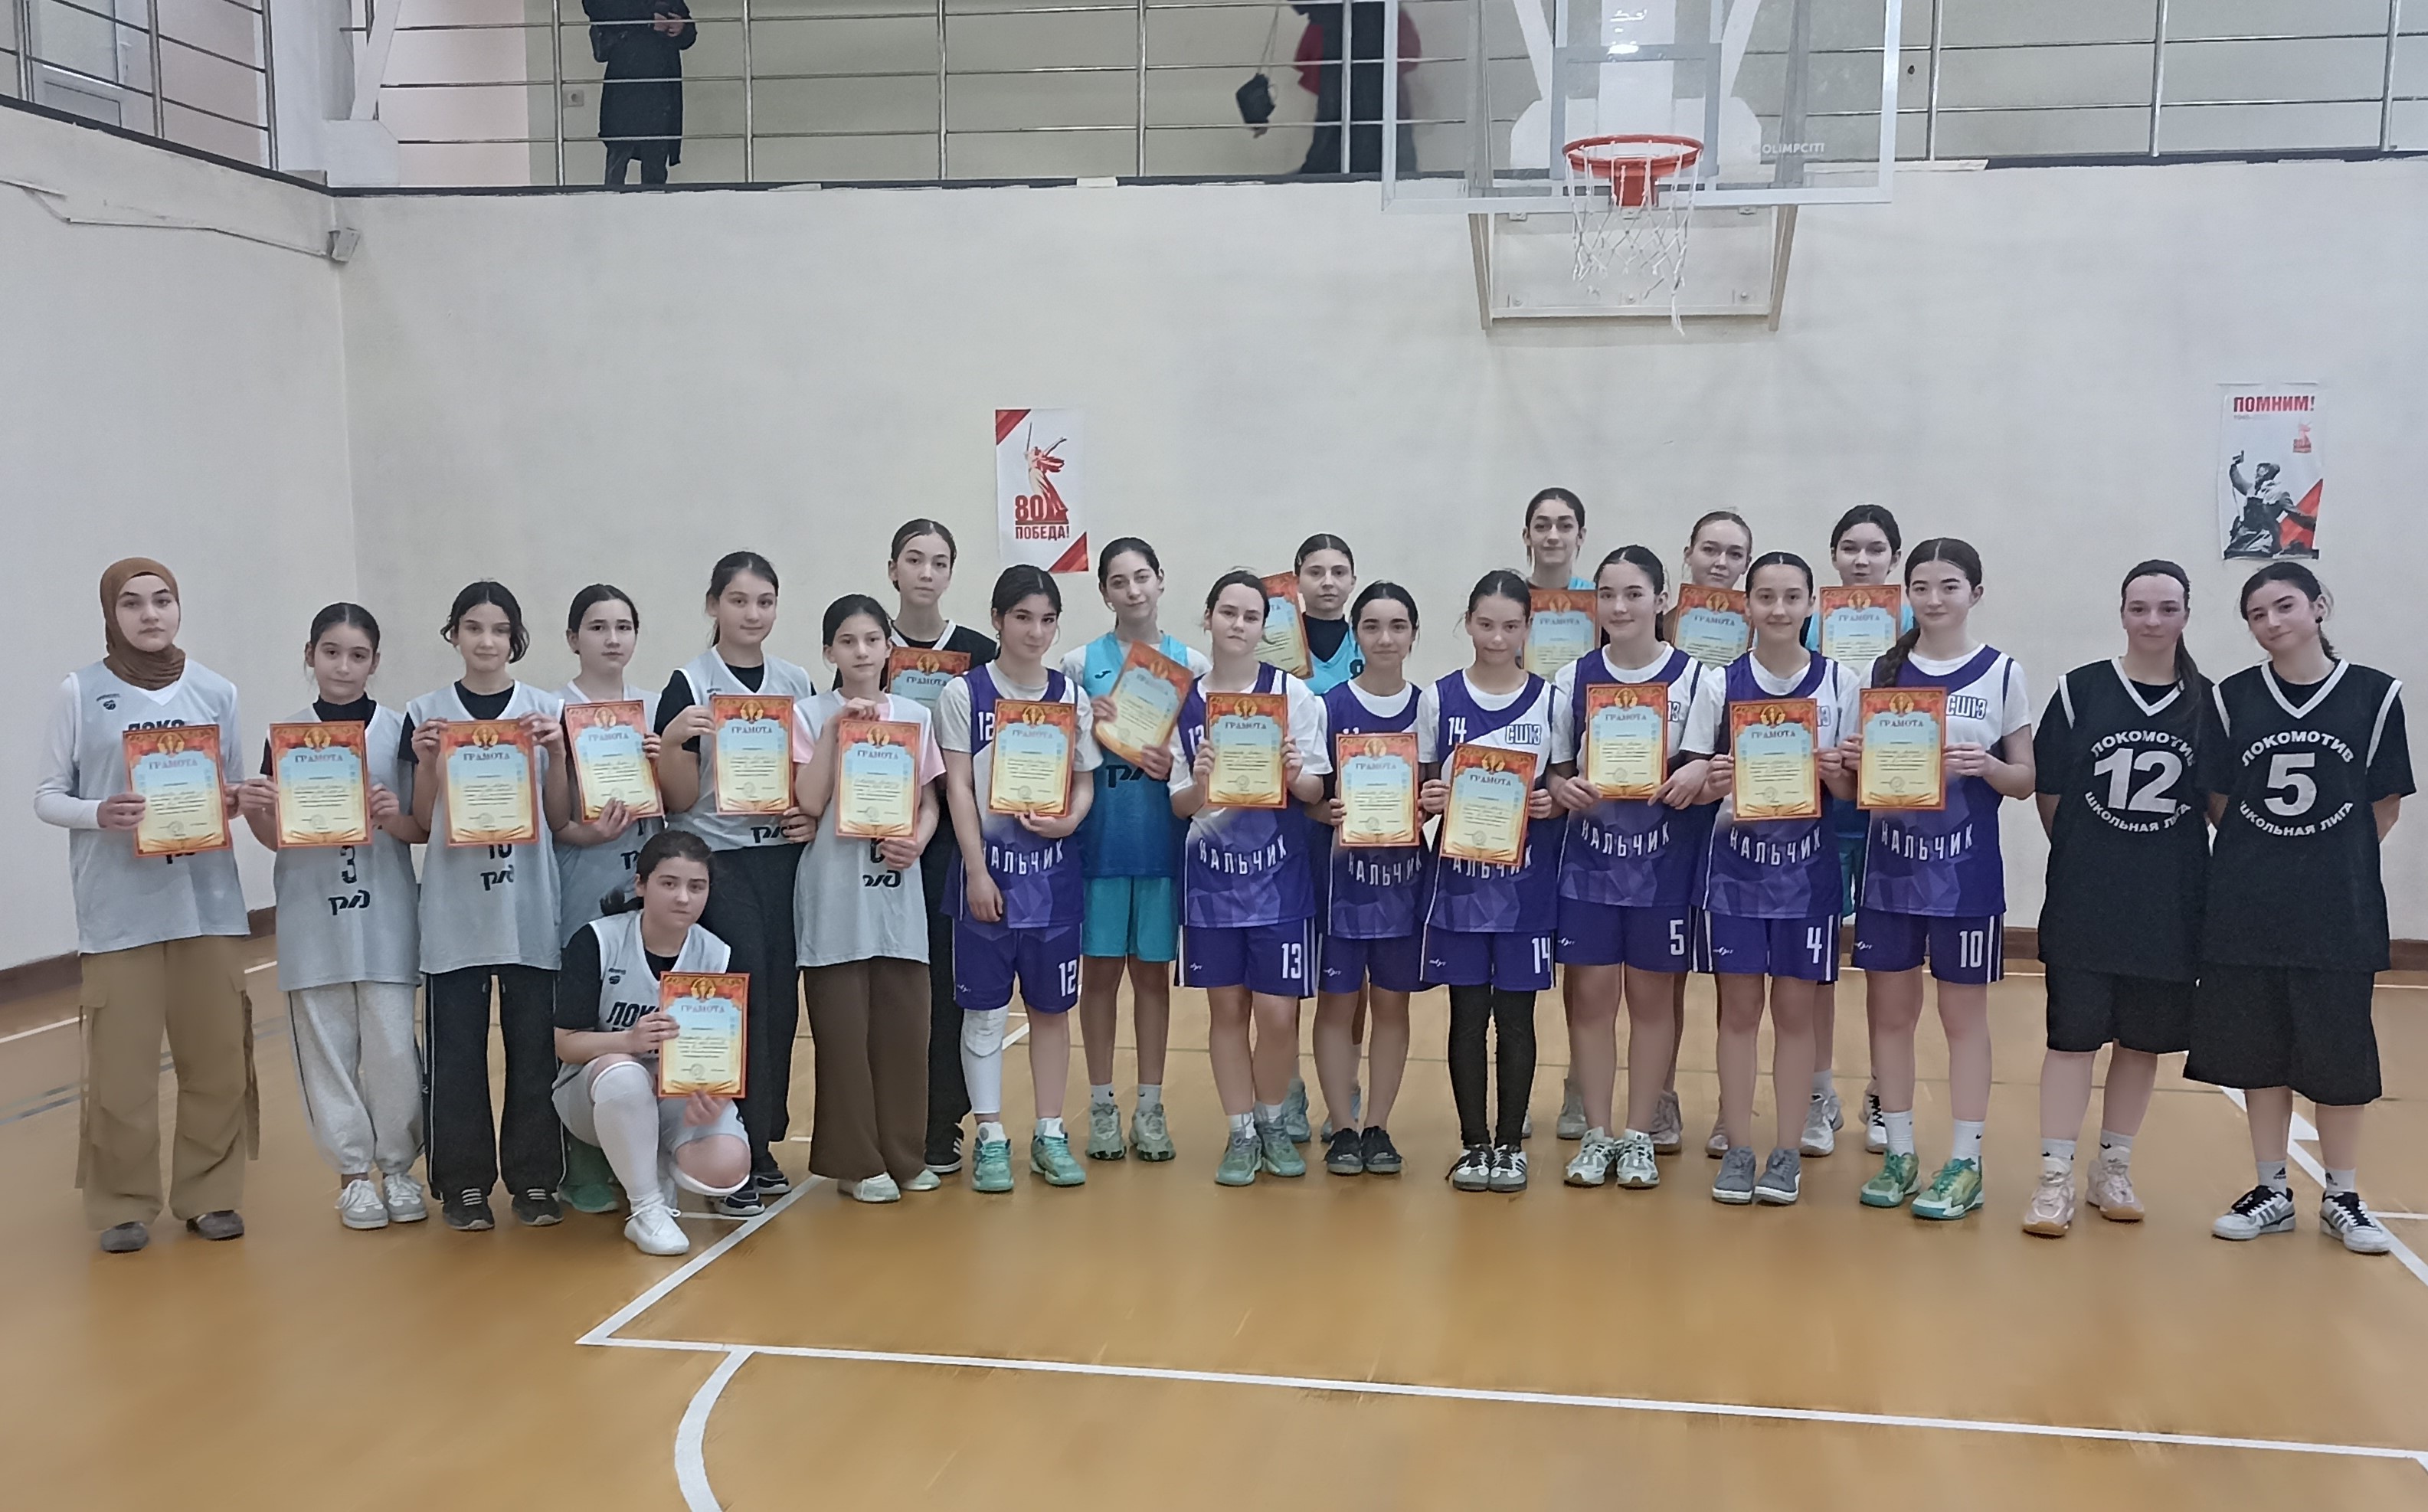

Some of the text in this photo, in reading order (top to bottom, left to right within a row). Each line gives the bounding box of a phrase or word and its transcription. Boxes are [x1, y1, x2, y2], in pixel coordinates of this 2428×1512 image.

[1762, 142, 1824, 154] OLIMPCITI
[2233, 395, 2315, 413] ПОМНИМ!
[1015, 495, 1045, 522] 80
[1015, 525, 1070, 541] ПОБЕДА!
[978, 712, 995, 741] 12
[1448, 716, 1468, 746] 14
[2241, 731, 2354, 767] ЛОКОМОТИВ
[2094, 748, 2183, 813] 12
[2263, 752, 2318, 817] 5
[2085, 791, 2159, 833] ШКОЛЬНАЯ
[2240, 800, 2354, 836] ШКОЛЬНАЯ ЛИГА
[1199, 834, 1287, 874] НАЛЬЧИК
[1581, 819, 1670, 857] НАЛЬЧИК
[1729, 826, 1821, 866] НАЛЬЧИК
[1881, 820, 1973, 860] НАЛЬЧИК
[339, 845, 358, 884] 3
[1348, 850, 1422, 886] НАЛЬЧИК
[1531, 936, 1551, 974] 14
[1670, 918, 1686, 957] 5
[1805, 926, 1823, 964] 4
[1958, 930, 1984, 968] 10
[1059, 959, 1078, 997] 12
[1281, 942, 1302, 979] 13
